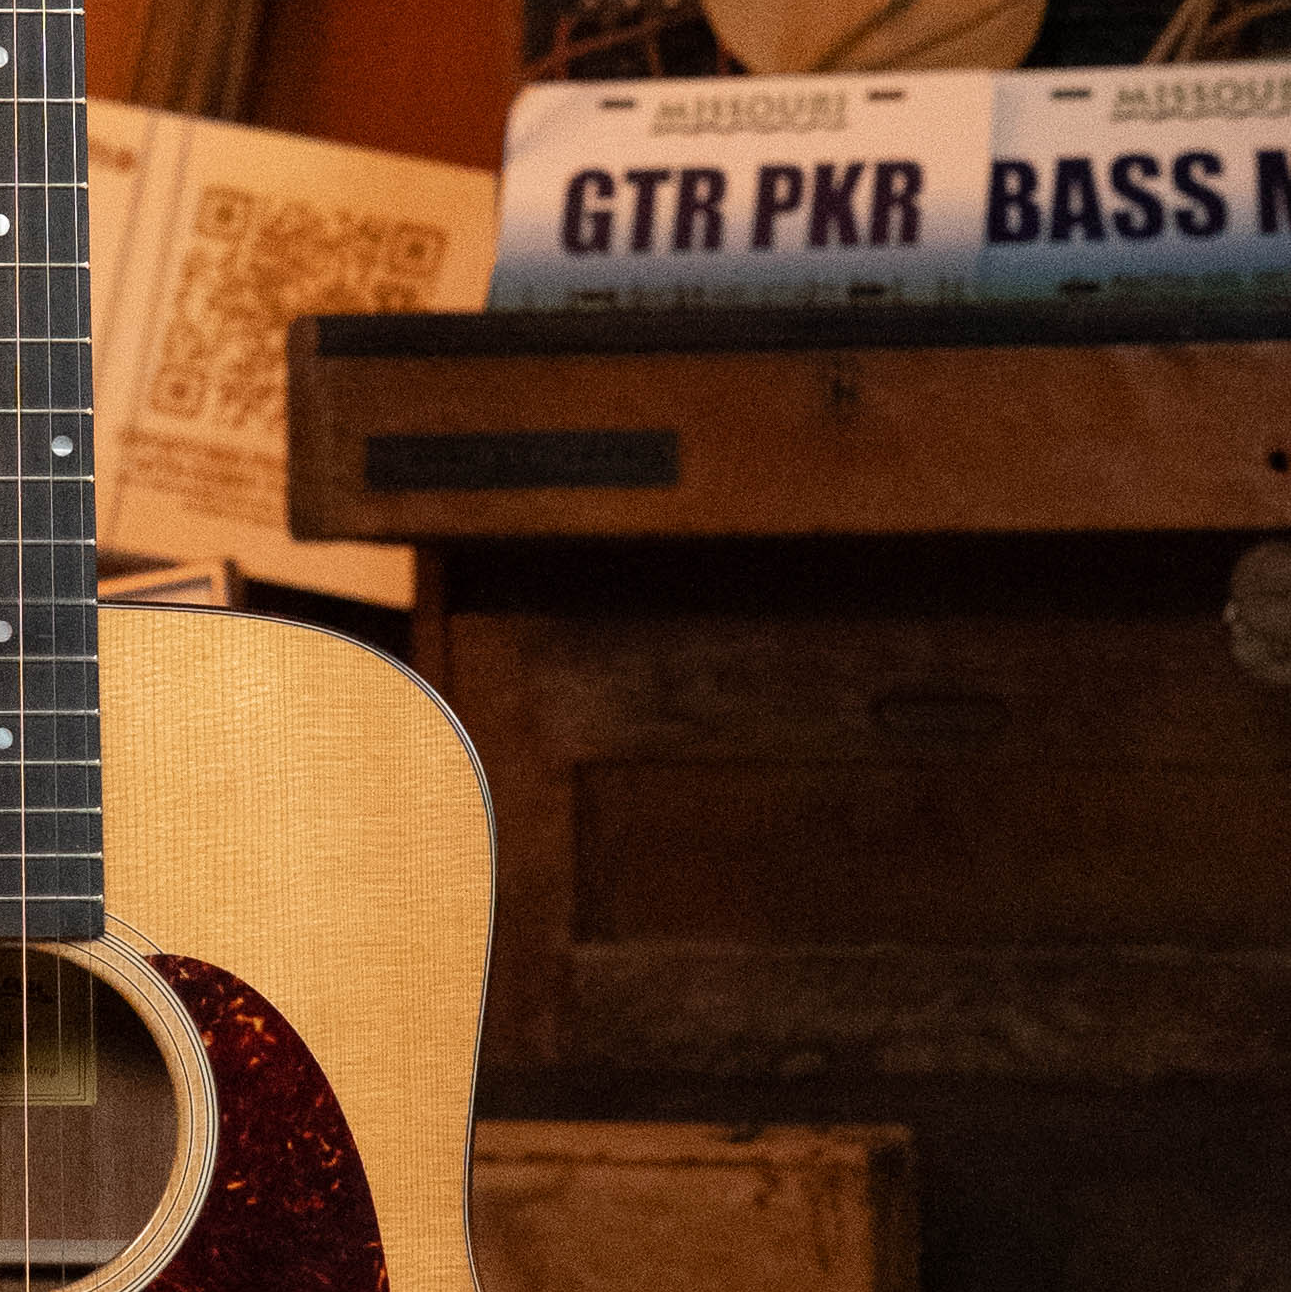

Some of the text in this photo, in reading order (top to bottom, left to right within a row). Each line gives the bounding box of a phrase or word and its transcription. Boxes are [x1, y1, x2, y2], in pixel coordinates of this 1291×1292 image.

[561, 160, 924, 255] GTR PKR
[986, 149, 1229, 244] BASS
